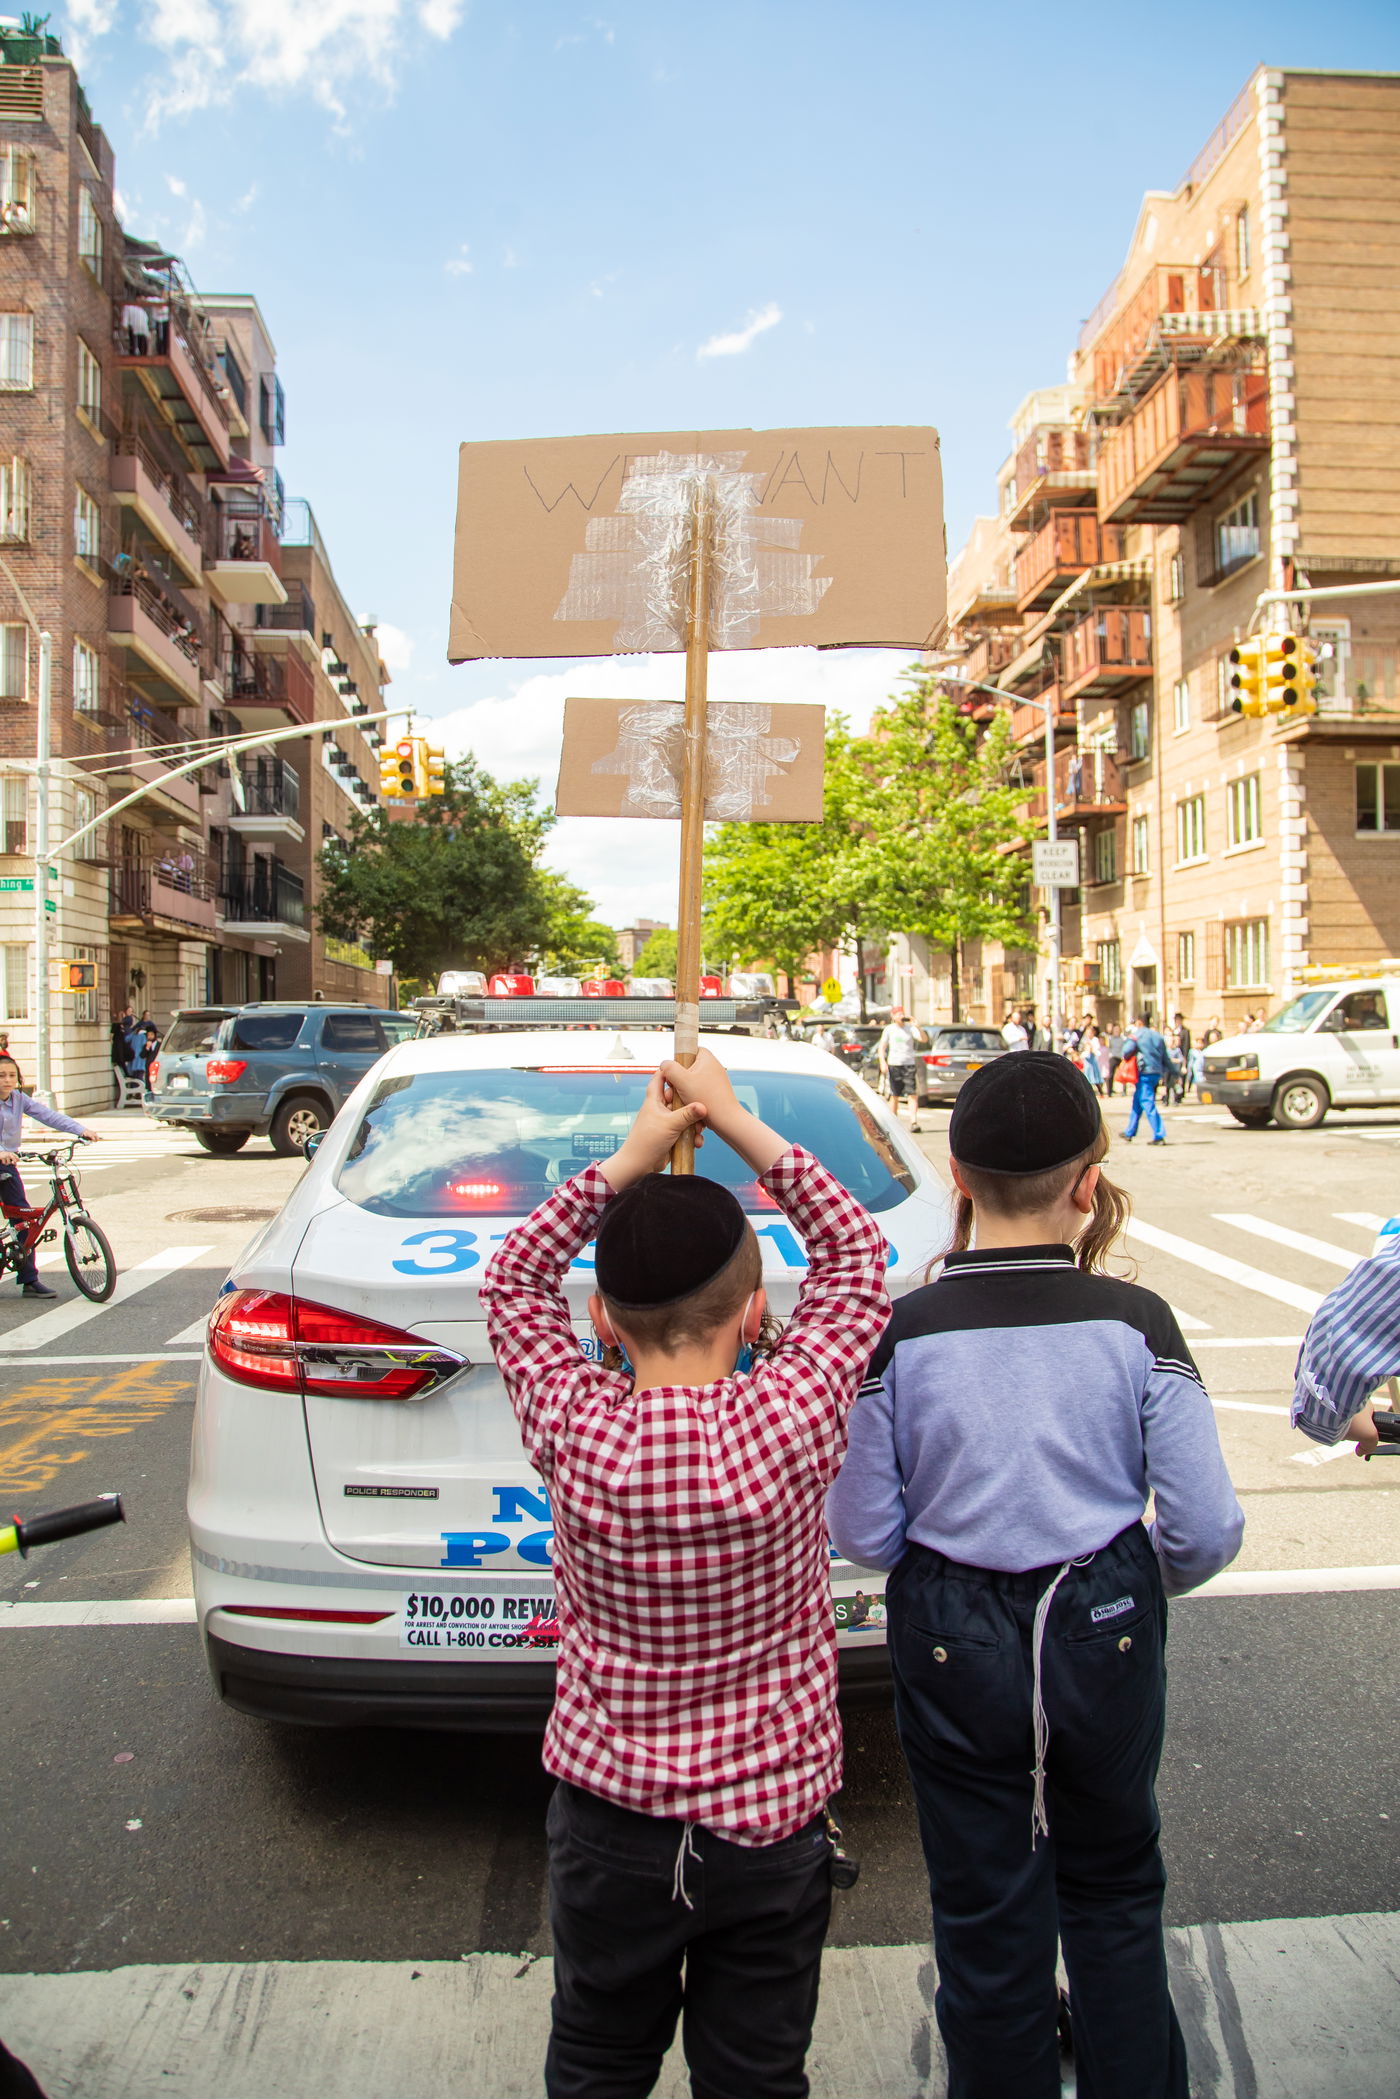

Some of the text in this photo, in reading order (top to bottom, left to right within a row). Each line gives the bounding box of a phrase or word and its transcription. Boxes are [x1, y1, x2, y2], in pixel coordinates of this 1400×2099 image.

[0, 879, 22, 891] hing
[346, 1487, 436, 1497] POLICE RESPONDER
[407, 1593, 495, 1622] $10,000
[407, 1630, 441, 1646] CALL
[446, 1630, 485, 1647] 1-800
